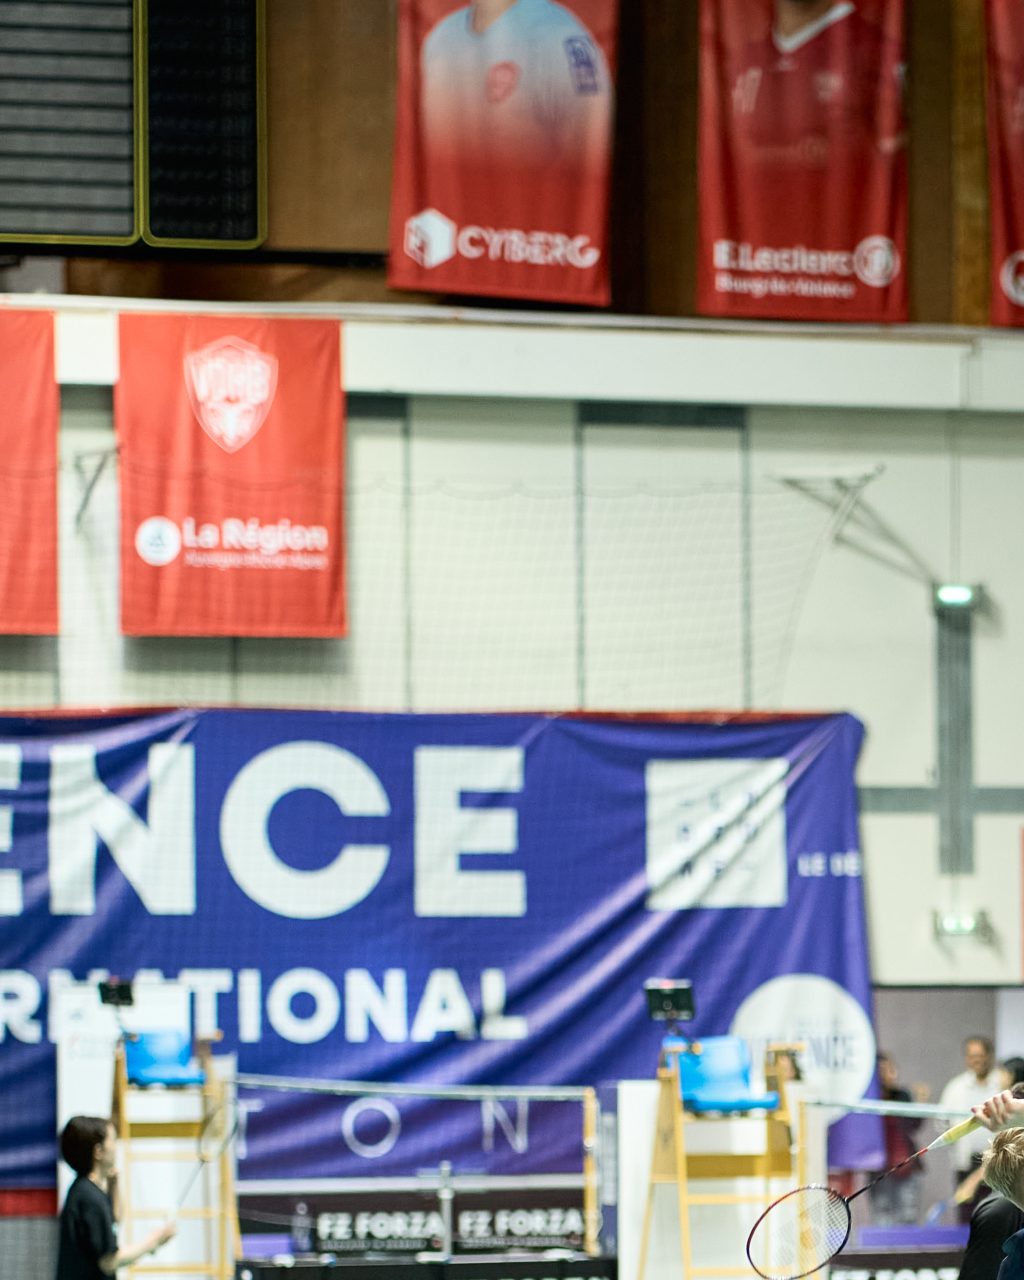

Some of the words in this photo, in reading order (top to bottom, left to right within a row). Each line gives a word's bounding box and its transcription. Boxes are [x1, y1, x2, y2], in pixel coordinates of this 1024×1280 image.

[0, 740, 527, 920] NCE
[317, 1212, 352, 1240] FZ
[355, 1210, 445, 1239] FORZA
[458, 1210, 493, 1238] FZ
[495, 1208, 585, 1236] FORZA
